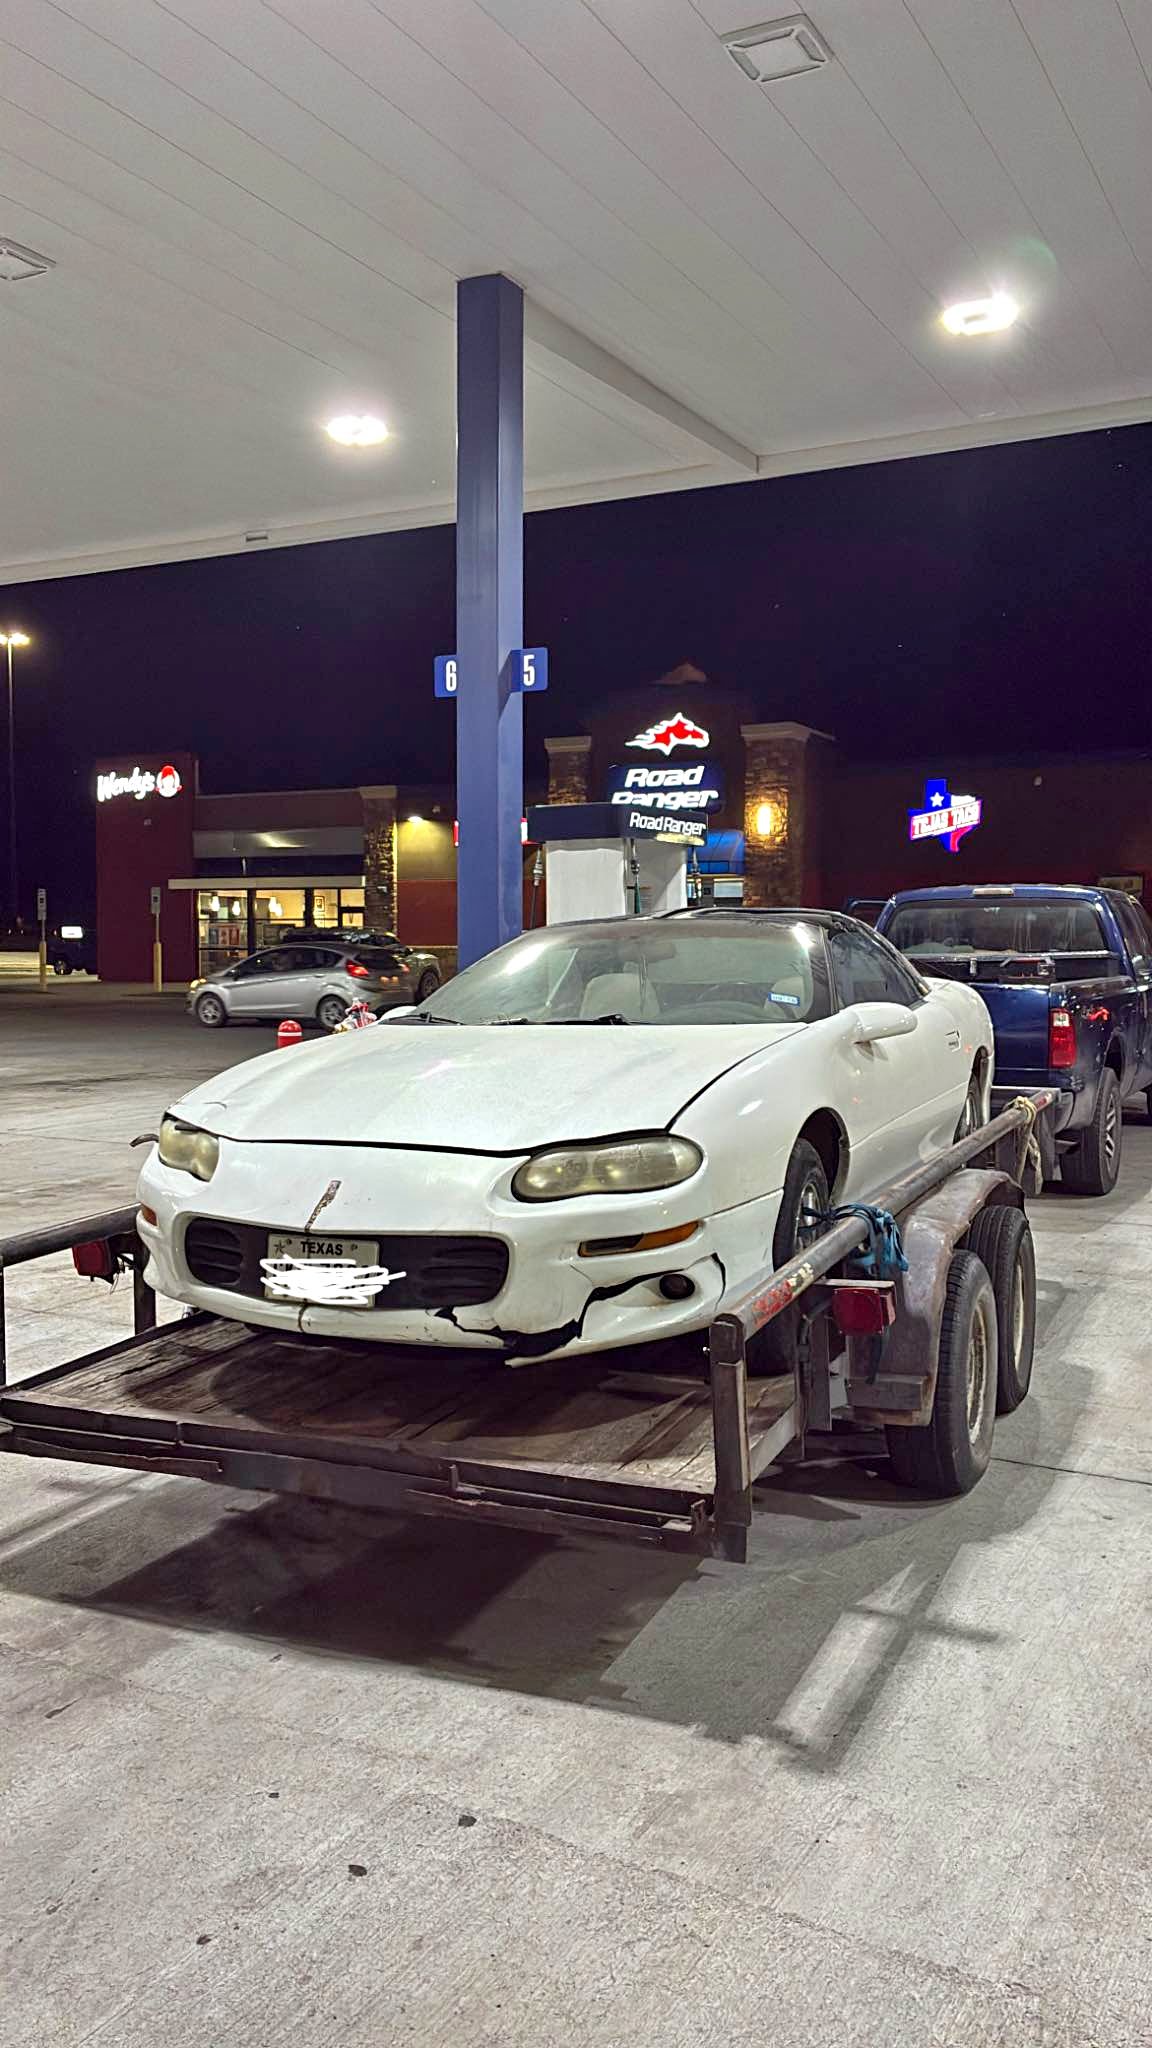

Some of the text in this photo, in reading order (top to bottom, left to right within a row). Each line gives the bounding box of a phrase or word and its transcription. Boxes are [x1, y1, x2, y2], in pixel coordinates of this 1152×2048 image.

[445, 660, 457, 692] 6
[523, 654, 536, 687] 5
[97, 766, 156, 802] Wendy's
[624, 766, 705, 788] Road
[611, 790, 719, 810] Ranger
[629, 812, 707, 836] Road Ranger
[300, 1240, 344, 1256] TEXAS
